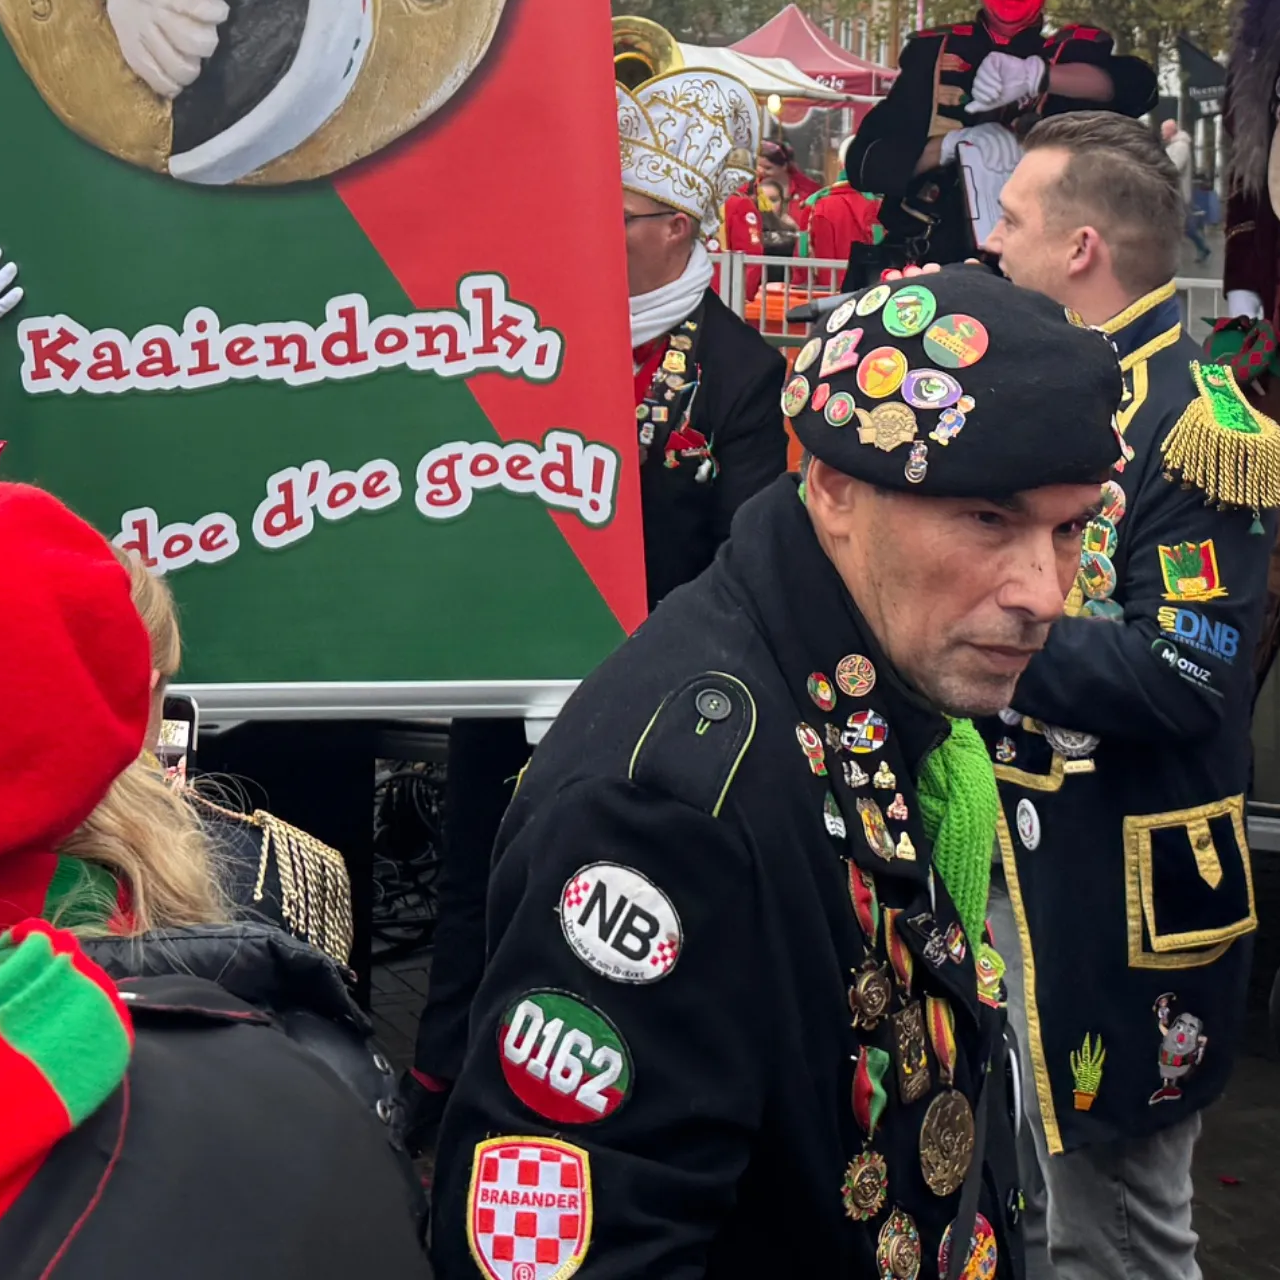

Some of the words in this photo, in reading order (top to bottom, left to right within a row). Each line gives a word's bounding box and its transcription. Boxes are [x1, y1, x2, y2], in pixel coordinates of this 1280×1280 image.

[24, 284, 550, 384] Kaaiendonk,
[119, 519, 231, 569] doe
[260, 464, 393, 540] d'oe
[423, 441, 607, 514] goed!
[1175, 608, 1240, 658] DNB
[577, 878, 661, 962] NB
[503, 999, 624, 1114] 0162
[480, 1188, 579, 1209] BRABANDER
